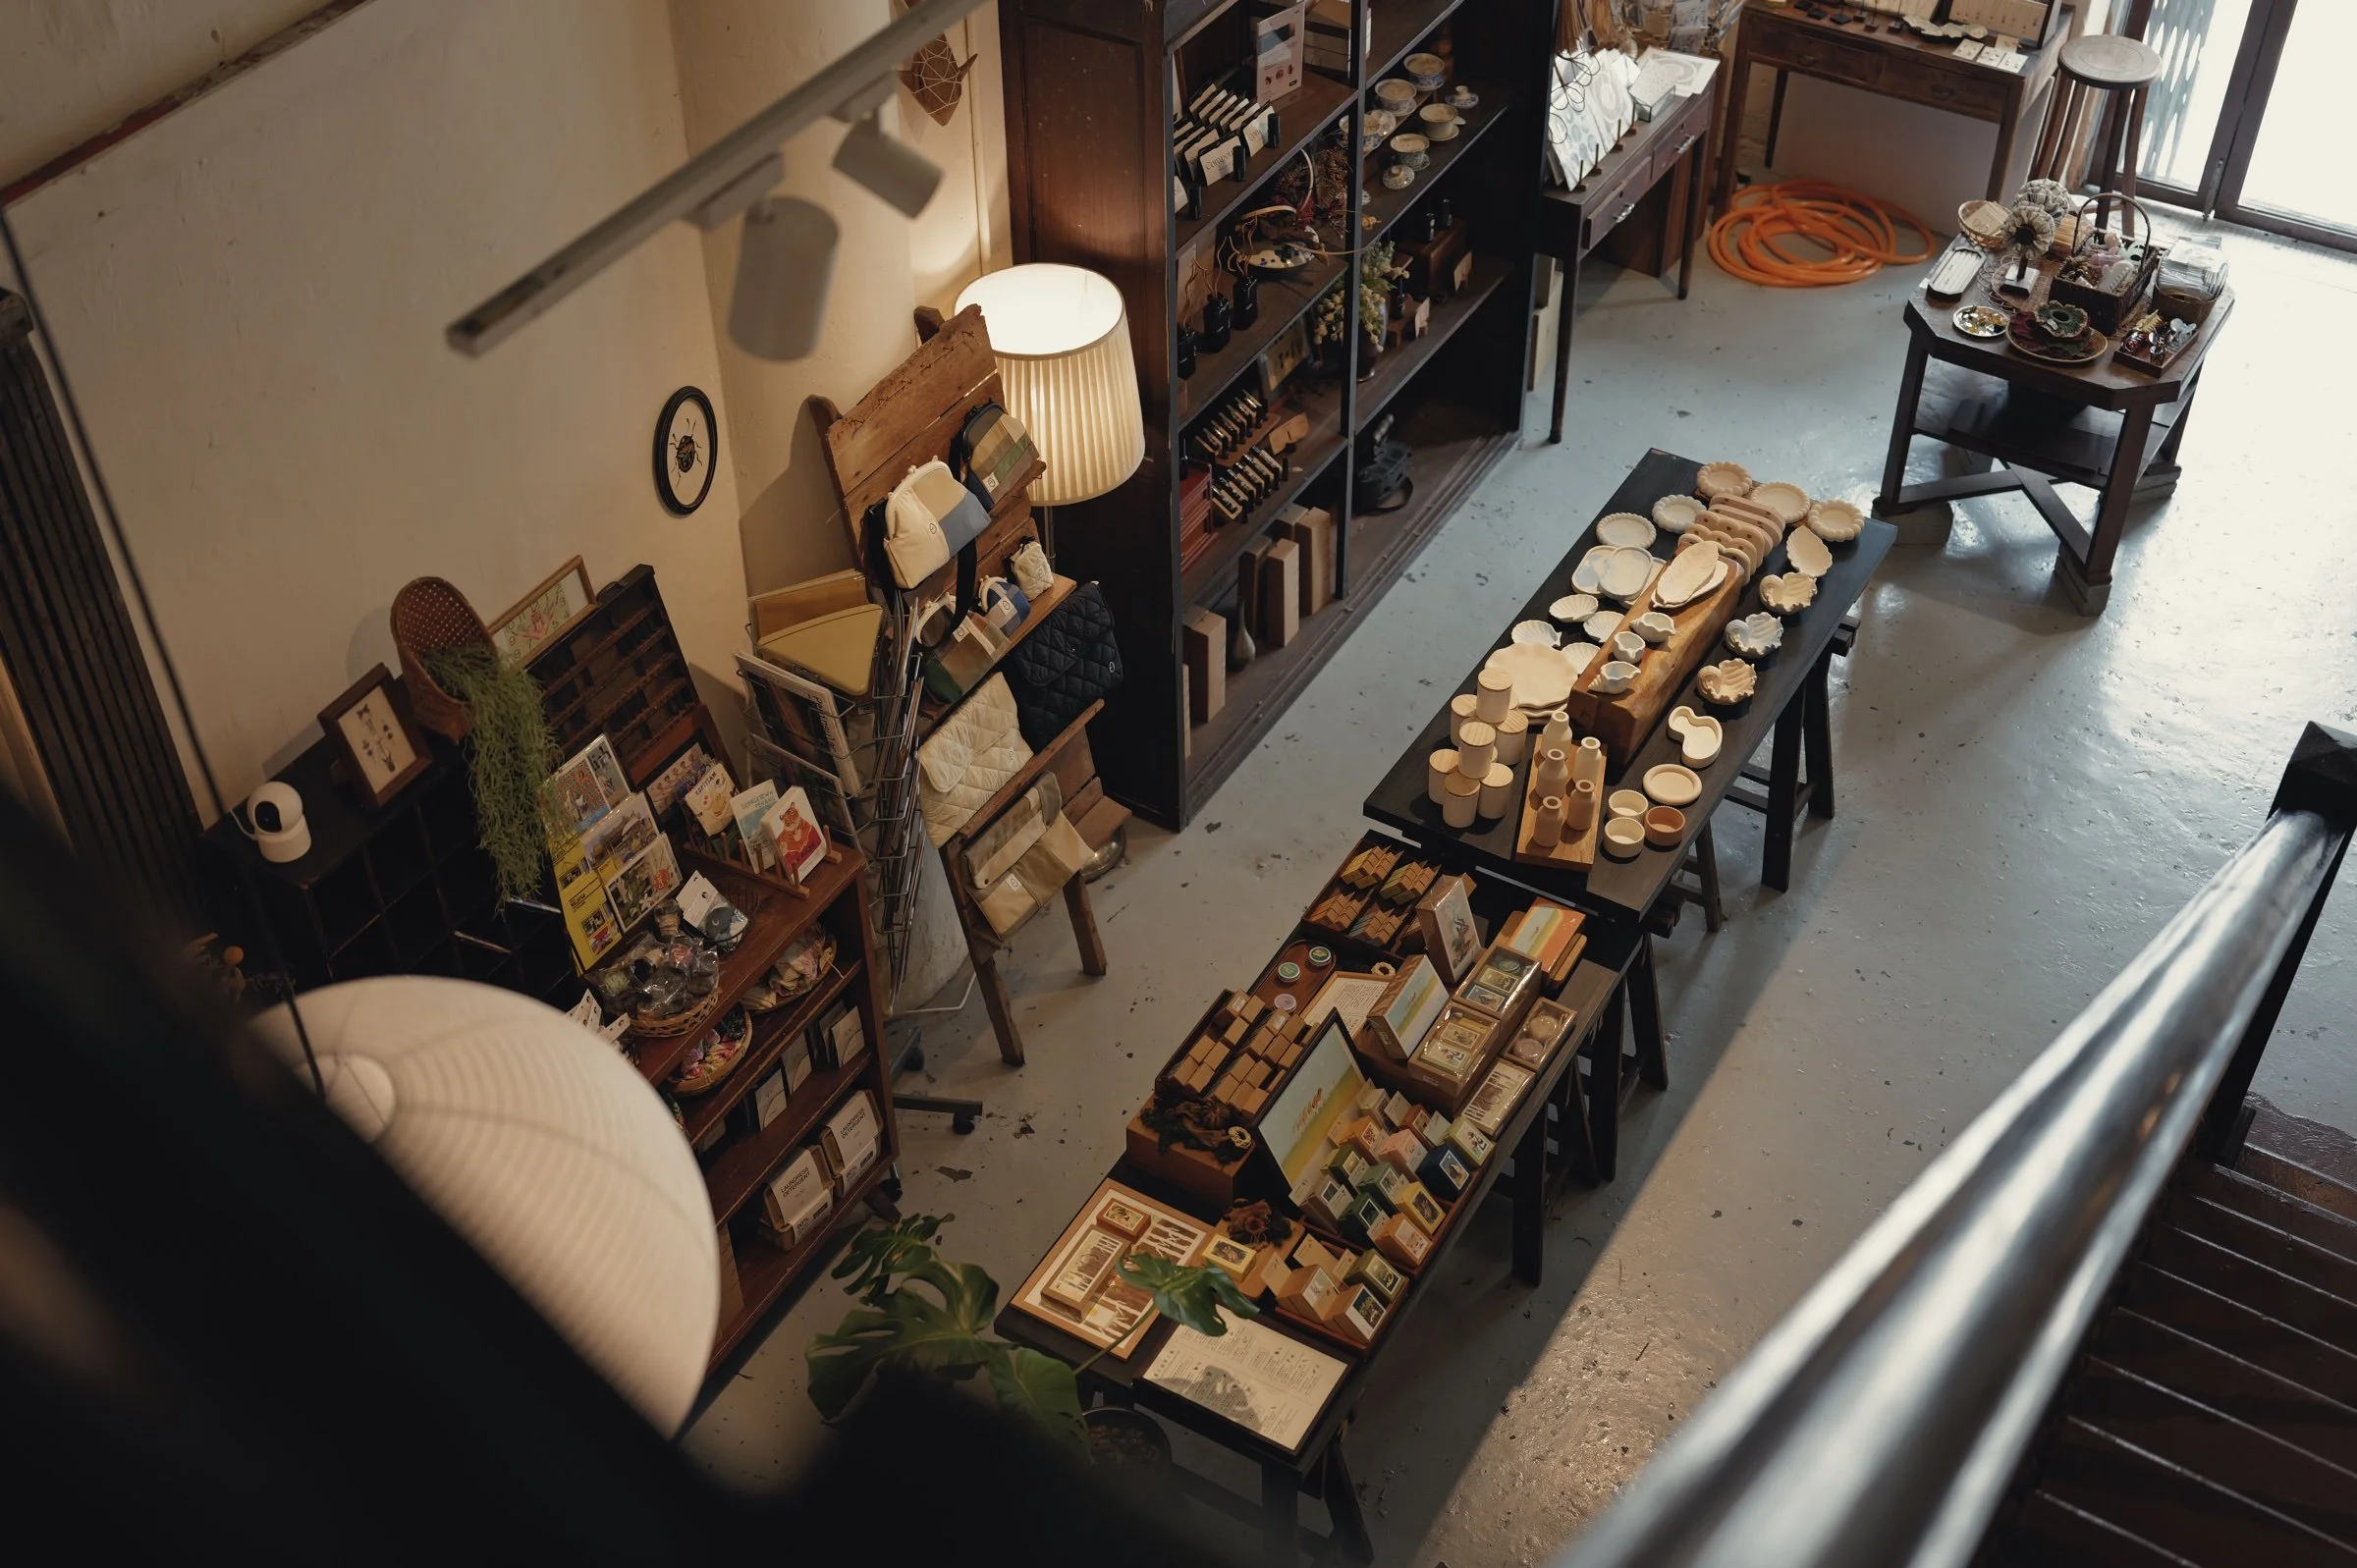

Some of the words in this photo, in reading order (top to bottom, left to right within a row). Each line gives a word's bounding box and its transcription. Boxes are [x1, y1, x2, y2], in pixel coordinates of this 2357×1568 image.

[1205, 149, 1233, 171] Compou
[840, 1107, 865, 1135] LAUNDRESS
[842, 1112, 866, 1139] DETERGENT
[781, 1166, 809, 1193] LAUNDRESS
[782, 1171, 810, 1198] DETERGENT
